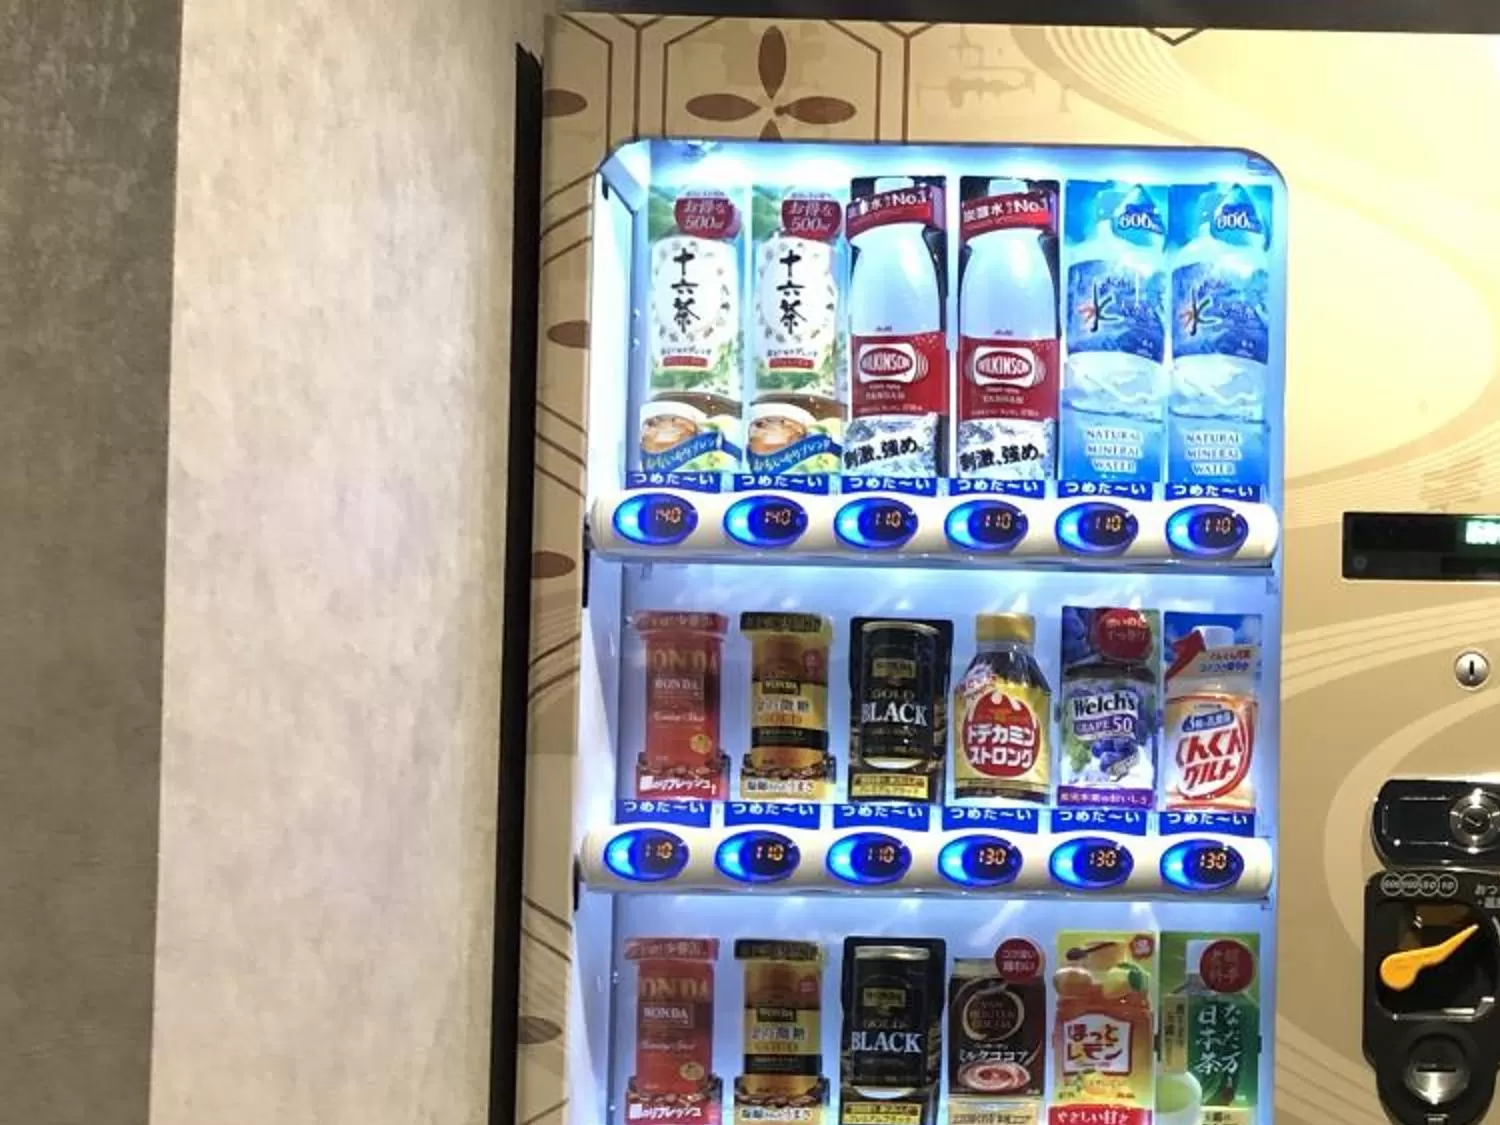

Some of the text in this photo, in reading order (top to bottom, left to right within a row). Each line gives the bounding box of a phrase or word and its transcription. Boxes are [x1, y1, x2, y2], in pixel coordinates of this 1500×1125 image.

[671, 248, 701, 334] 十六茶
[777, 247, 808, 335] 十六茶
[860, 701, 928, 727] BLACK
[969, 747, 1033, 768] ストロング
[850, 1031, 923, 1053] BLACK
[1067, 1023, 1119, 1043] ほっと
[1194, 1004, 1222, 1075] 日本茶
[1067, 1043, 1123, 1061] レモン
